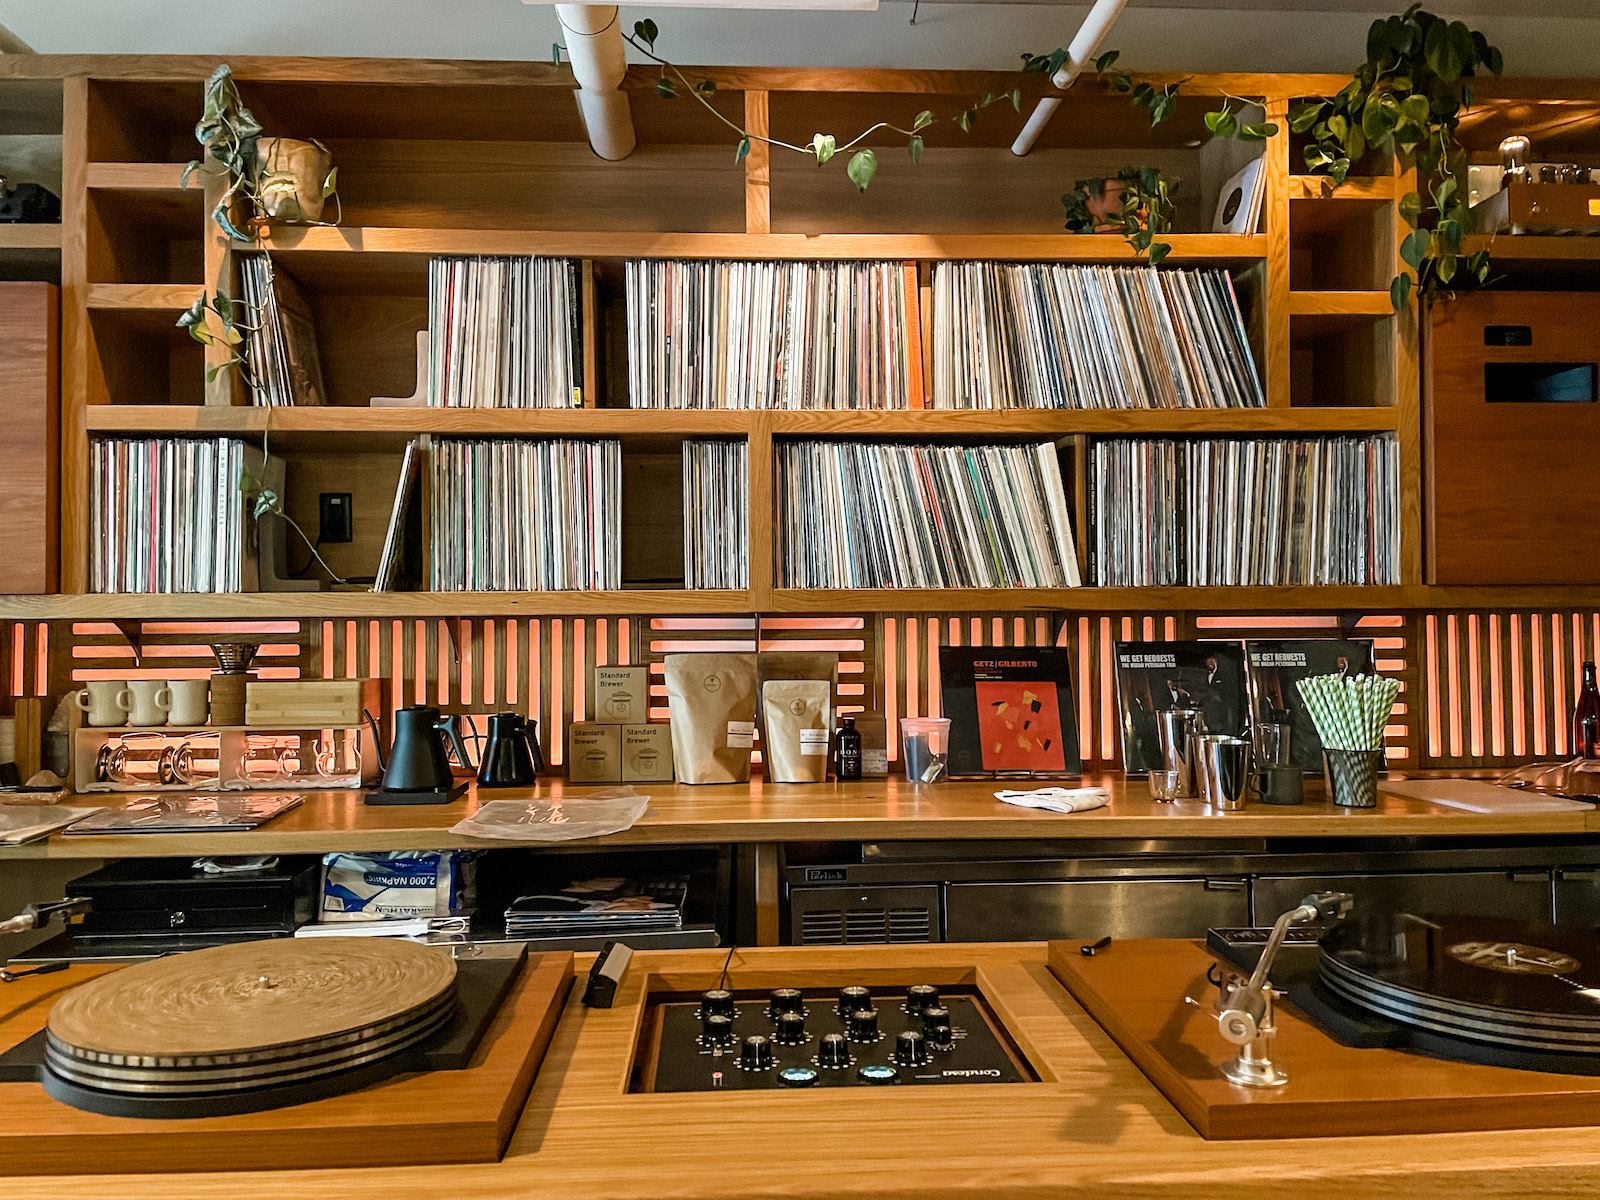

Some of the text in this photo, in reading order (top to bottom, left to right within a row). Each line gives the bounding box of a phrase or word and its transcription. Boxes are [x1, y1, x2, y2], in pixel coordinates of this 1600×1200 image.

[220, 456, 226, 469] AM
[1120, 654, 1176, 663] WE GET REQUESTS
[1250, 653, 1306, 661] WE GET REQUESTS
[810, 870, 844, 880] Perlick
[409, 876, 435, 885] 2,000
[375, 906, 433, 914] ARATHON
[942, 1068, 1001, 1078] Condesa
